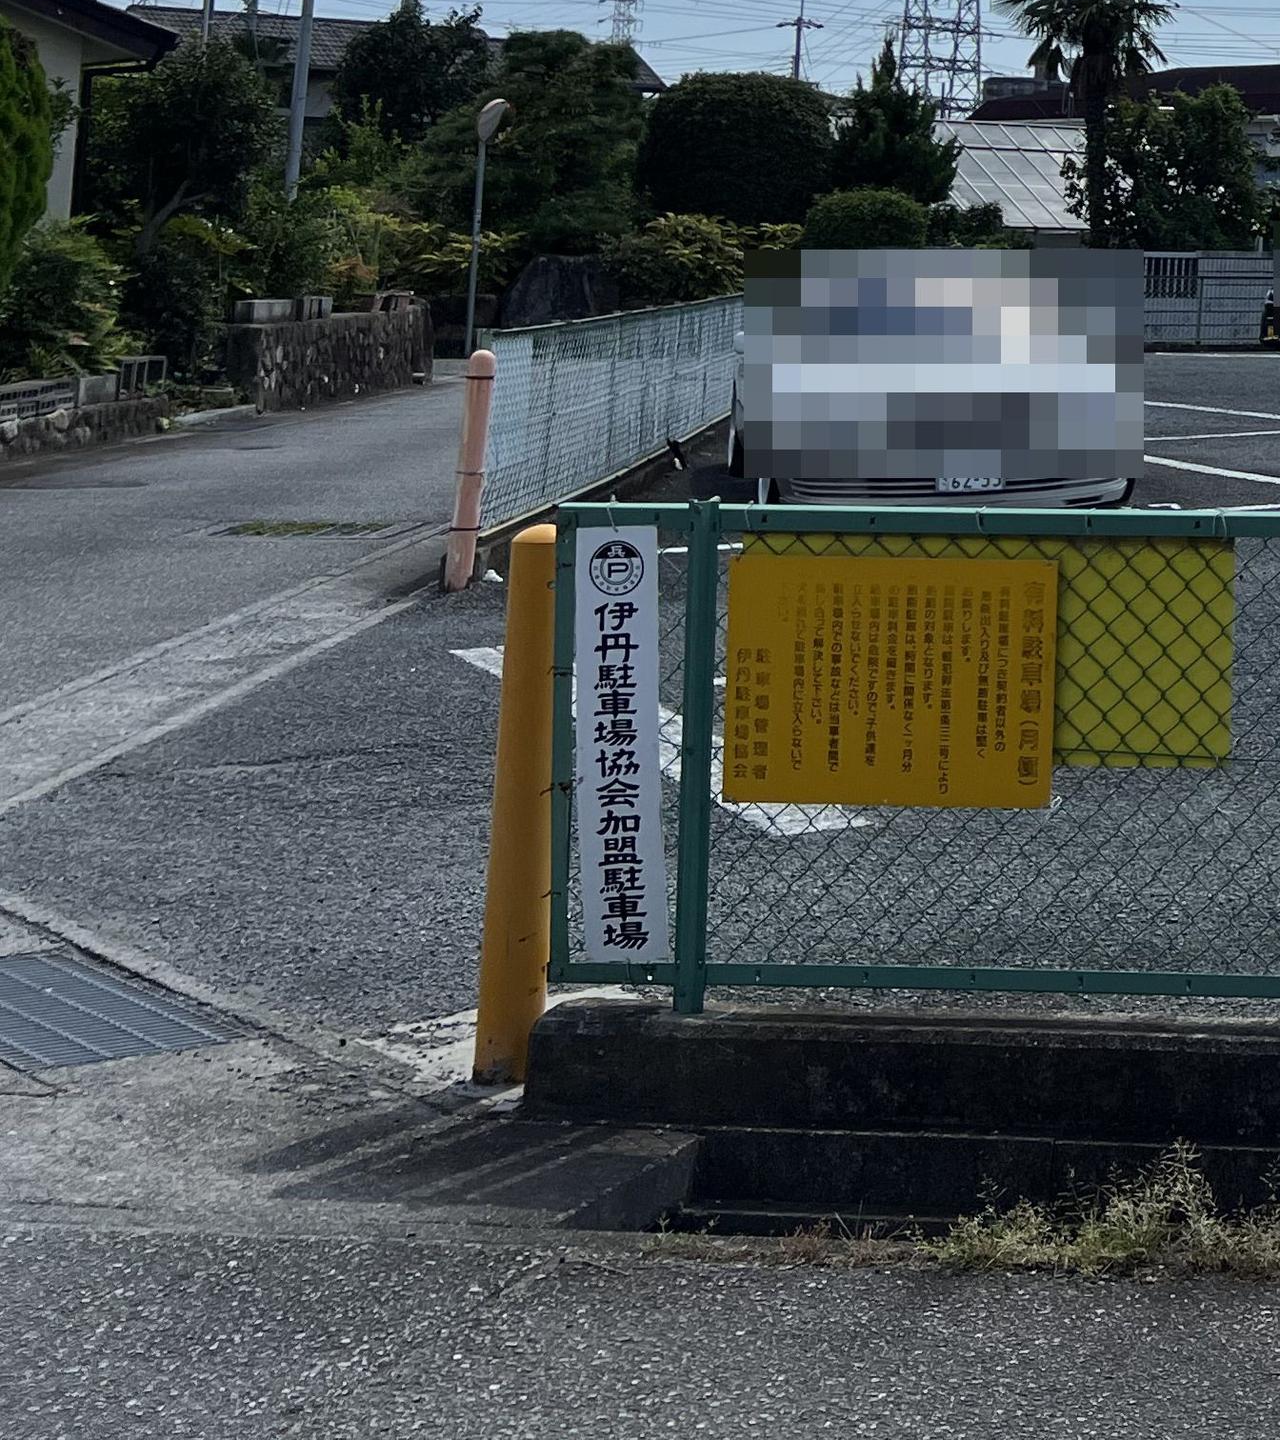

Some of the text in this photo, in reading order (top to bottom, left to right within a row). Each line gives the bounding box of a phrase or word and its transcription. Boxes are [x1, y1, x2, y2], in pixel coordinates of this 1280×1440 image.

[607, 562, 629, 578] P
[594, 601, 650, 951] 伊丹駐車場協会加盟駐車場
